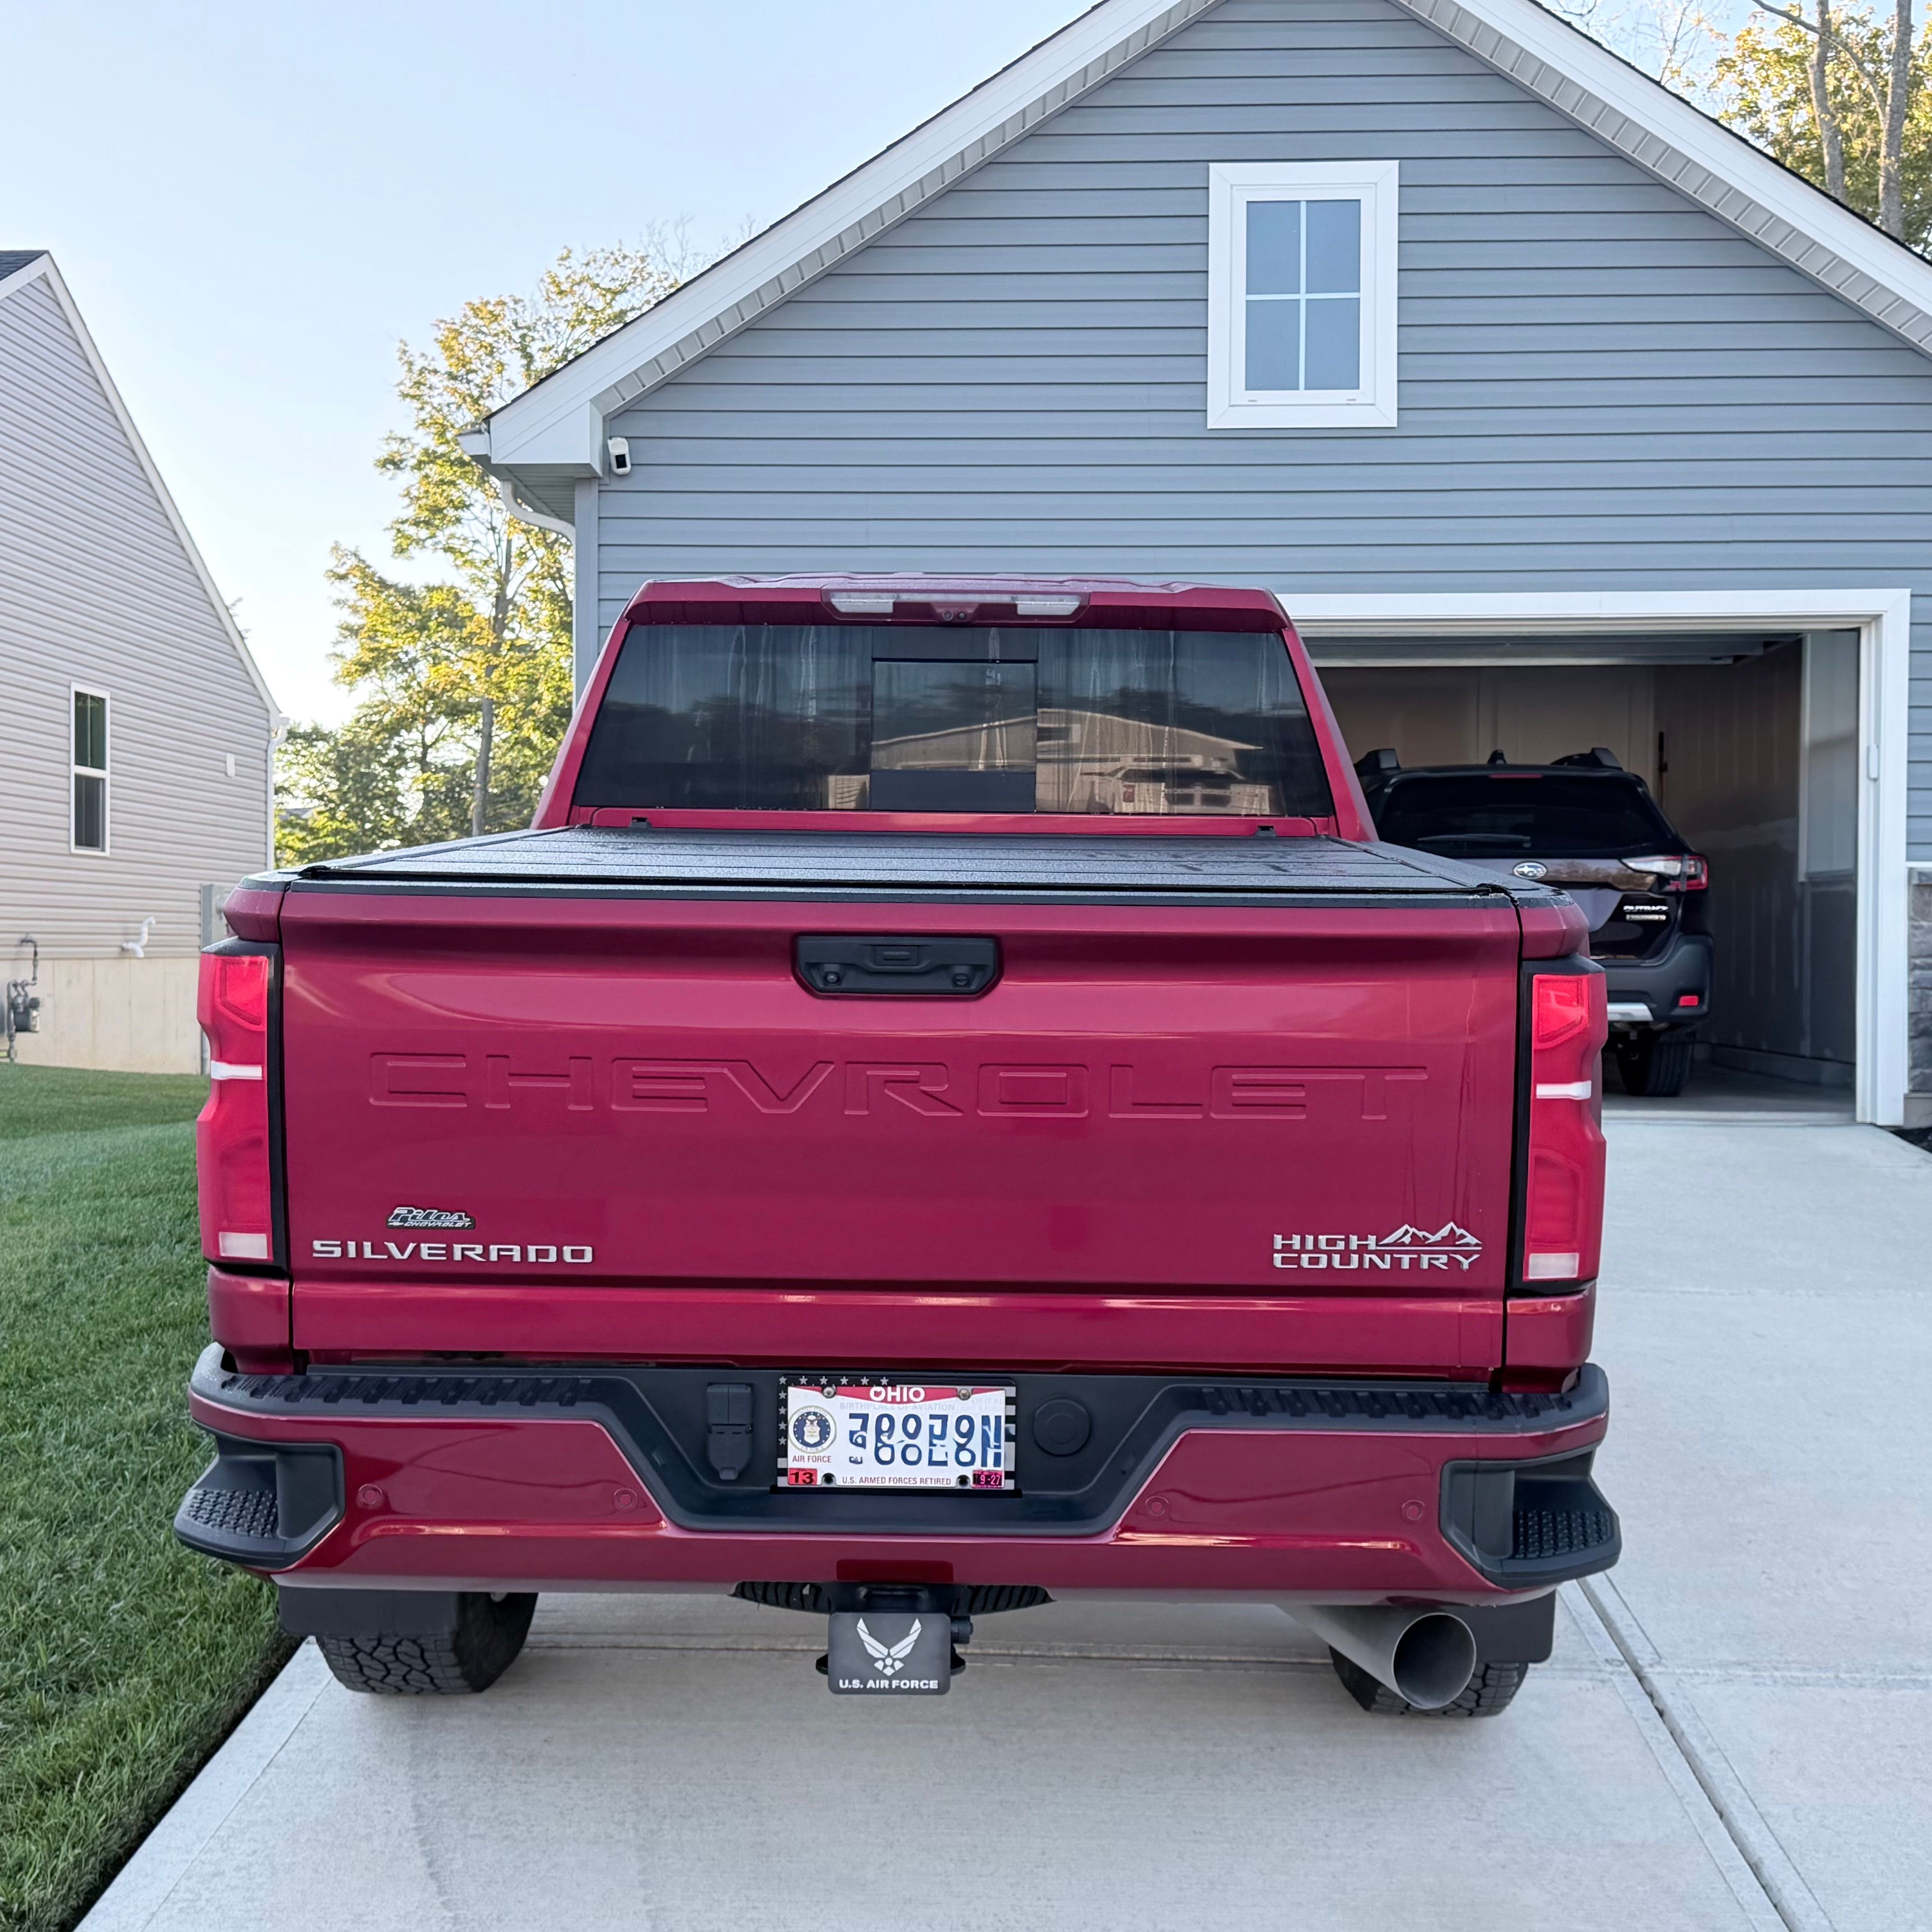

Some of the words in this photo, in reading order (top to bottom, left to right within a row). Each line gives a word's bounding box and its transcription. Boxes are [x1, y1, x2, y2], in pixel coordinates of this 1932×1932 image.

[368, 1053, 1428, 1120] CHEVROLET
[1273, 1234, 1377, 1250] HIGH
[312, 1240, 593, 1263] SILVERADO
[1273, 1253, 1481, 1270] COUNTRY
[869, 1386, 925, 1402] OHIO
[839, 1402, 895, 1411] BIRTHPLACE
[912, 1403, 955, 1411] AVIATION
[790, 1471, 814, 1484] 13
[842, 1476, 856, 1484] U.S.
[889, 1477, 917, 1485] FORCES
[920, 1477, 951, 1486] RETIRED
[839, 1679, 864, 1688] U.S.
[866, 1679, 889, 1689] AIR
[892, 1680, 938, 1689] FORCE
